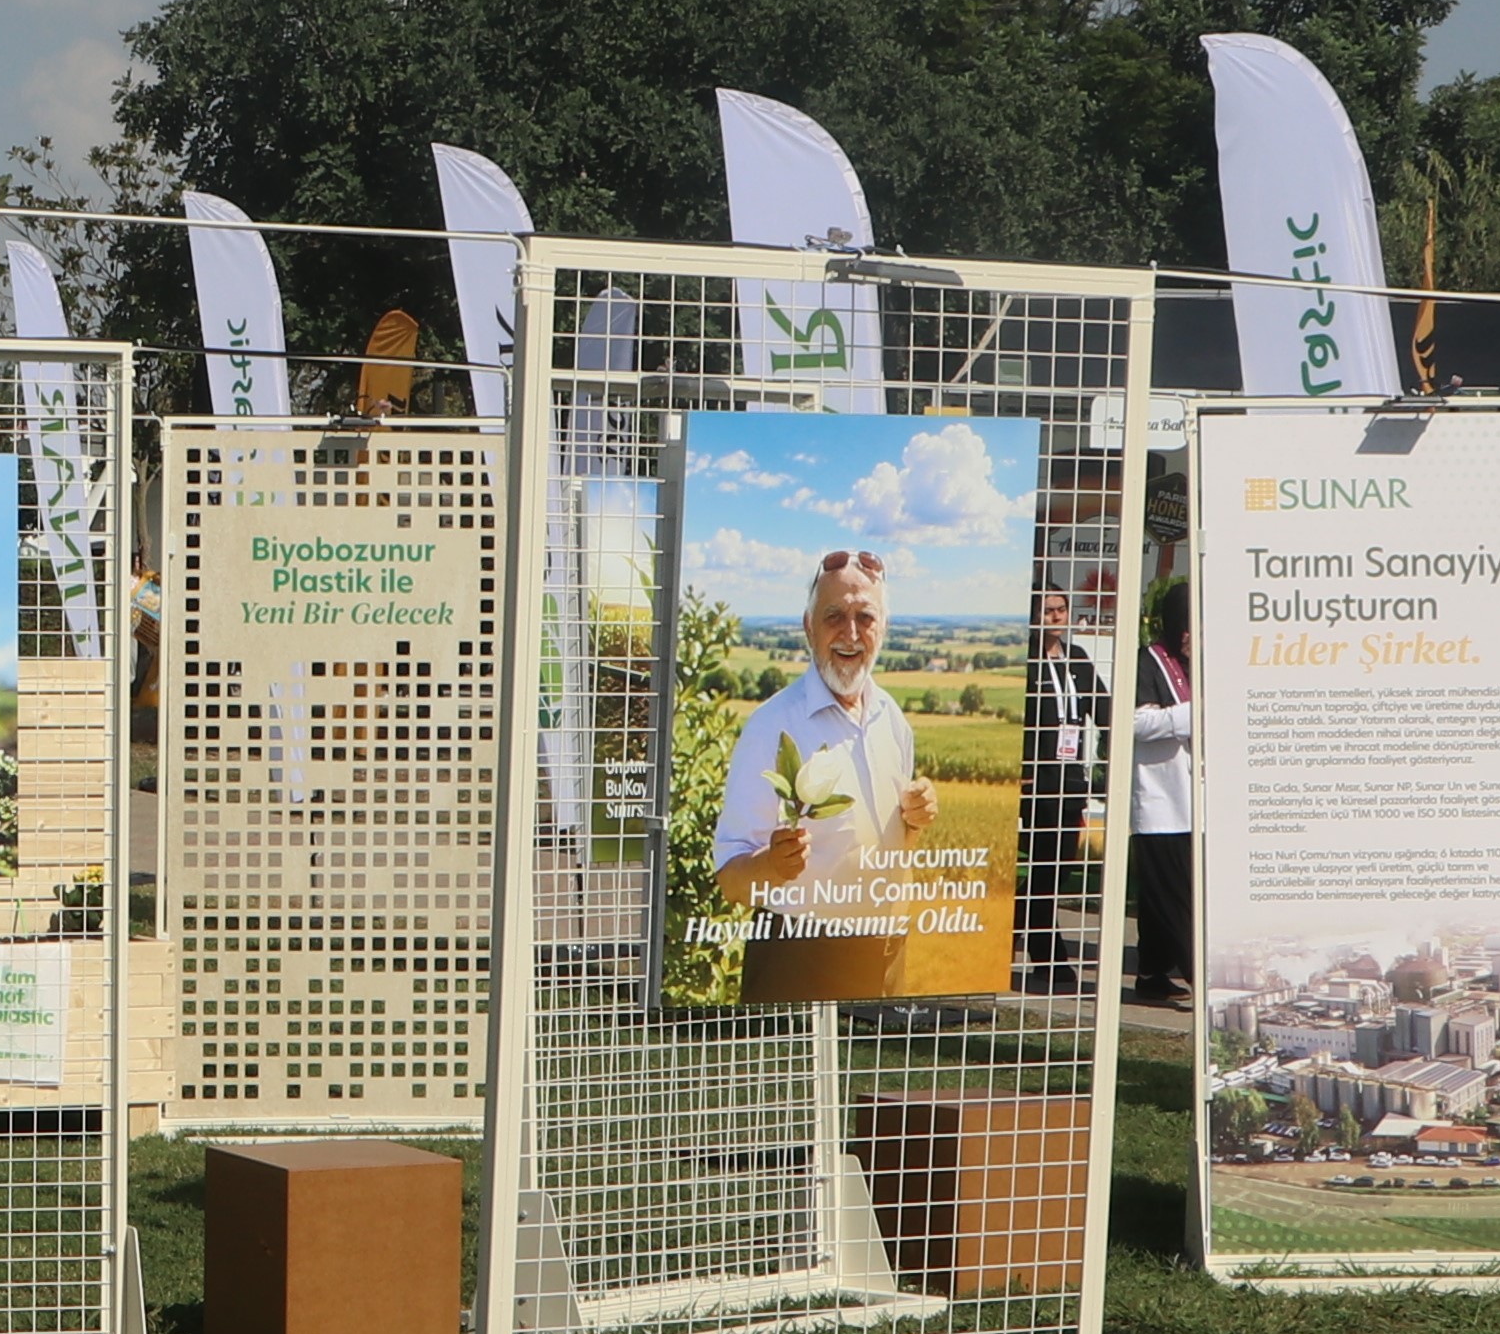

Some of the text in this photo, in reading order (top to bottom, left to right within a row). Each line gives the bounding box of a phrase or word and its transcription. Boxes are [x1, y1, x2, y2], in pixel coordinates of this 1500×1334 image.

[1147, 498, 1187, 520] HONE
[1279, 478, 1412, 510] SUNAR
[252, 536, 436, 567] Biyobozunur
[1246, 547, 1353, 579] Tarımı
[273, 568, 414, 593] Plastik ile
[241, 601, 454, 625] Yeni Bir Gelecek
[1248, 589, 1438, 628] Buluşturan
[1248, 631, 1481, 674] Lider Şirket.
[605, 779, 621, 796] Bu
[859, 845, 989, 870] Kurucumuz
[750, 876, 986, 907] Hacı Nuri Çomu'nun
[684, 906, 984, 951] Hayali Mirasımız Oldu.
[5, 972, 36, 984] am
